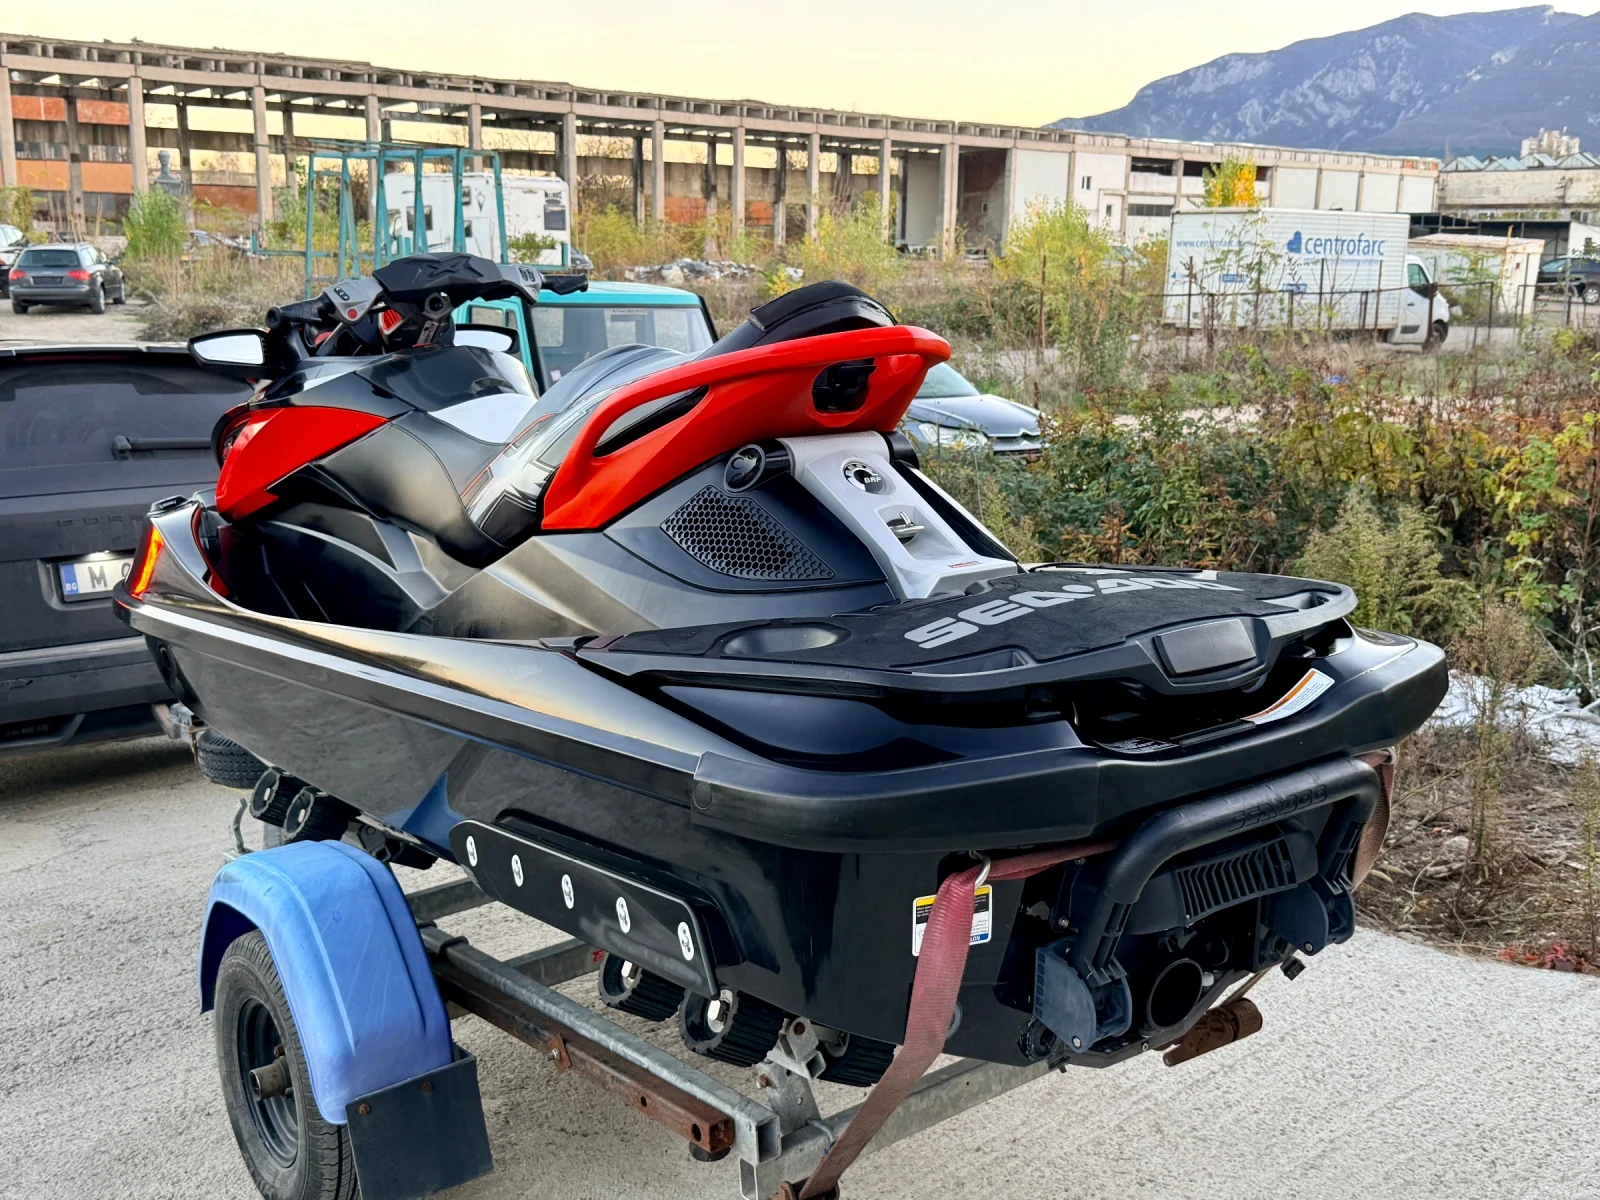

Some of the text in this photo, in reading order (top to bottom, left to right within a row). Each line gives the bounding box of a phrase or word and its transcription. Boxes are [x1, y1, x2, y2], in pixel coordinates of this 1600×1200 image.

[1304, 232, 1386, 256] centrofarc
[863, 476, 882, 484] BRP
[65, 582, 78, 591] BG
